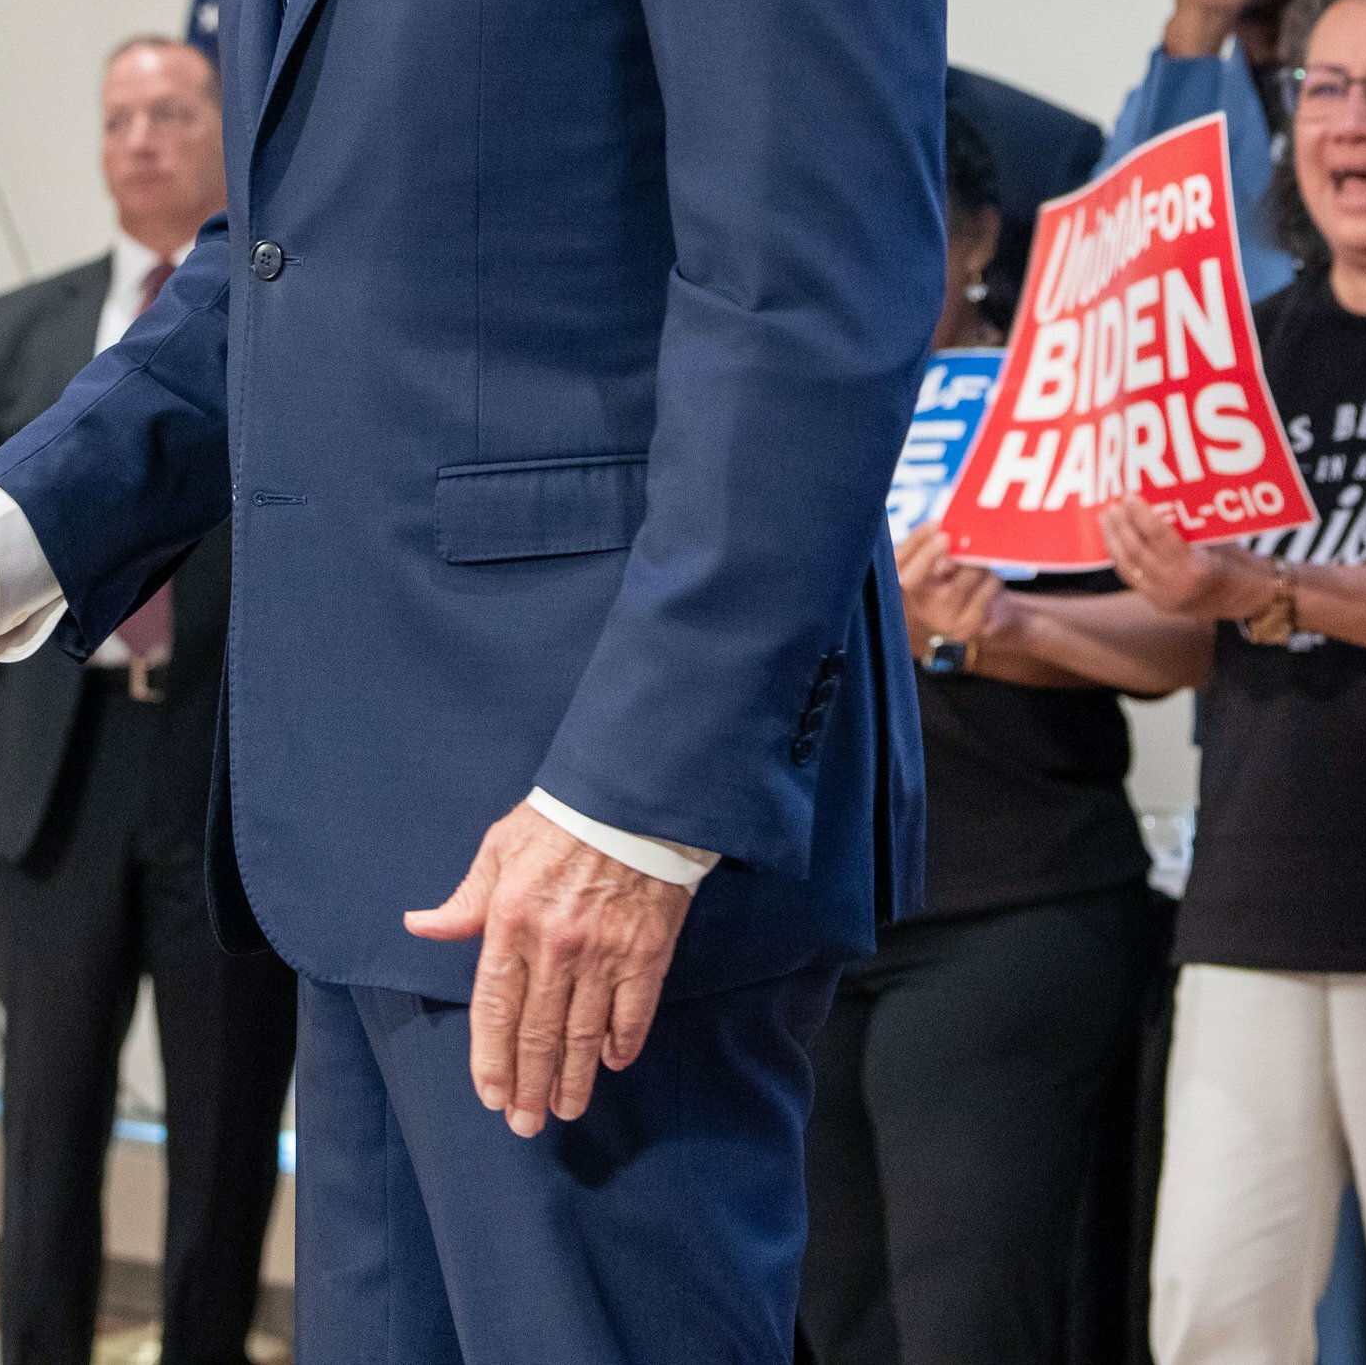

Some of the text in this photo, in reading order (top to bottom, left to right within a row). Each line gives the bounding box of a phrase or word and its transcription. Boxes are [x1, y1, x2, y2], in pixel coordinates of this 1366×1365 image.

[1141, 172, 1216, 250] FOR
[1013, 257, 1237, 422] BIDEN
[977, 380, 1267, 511] HARRIS
